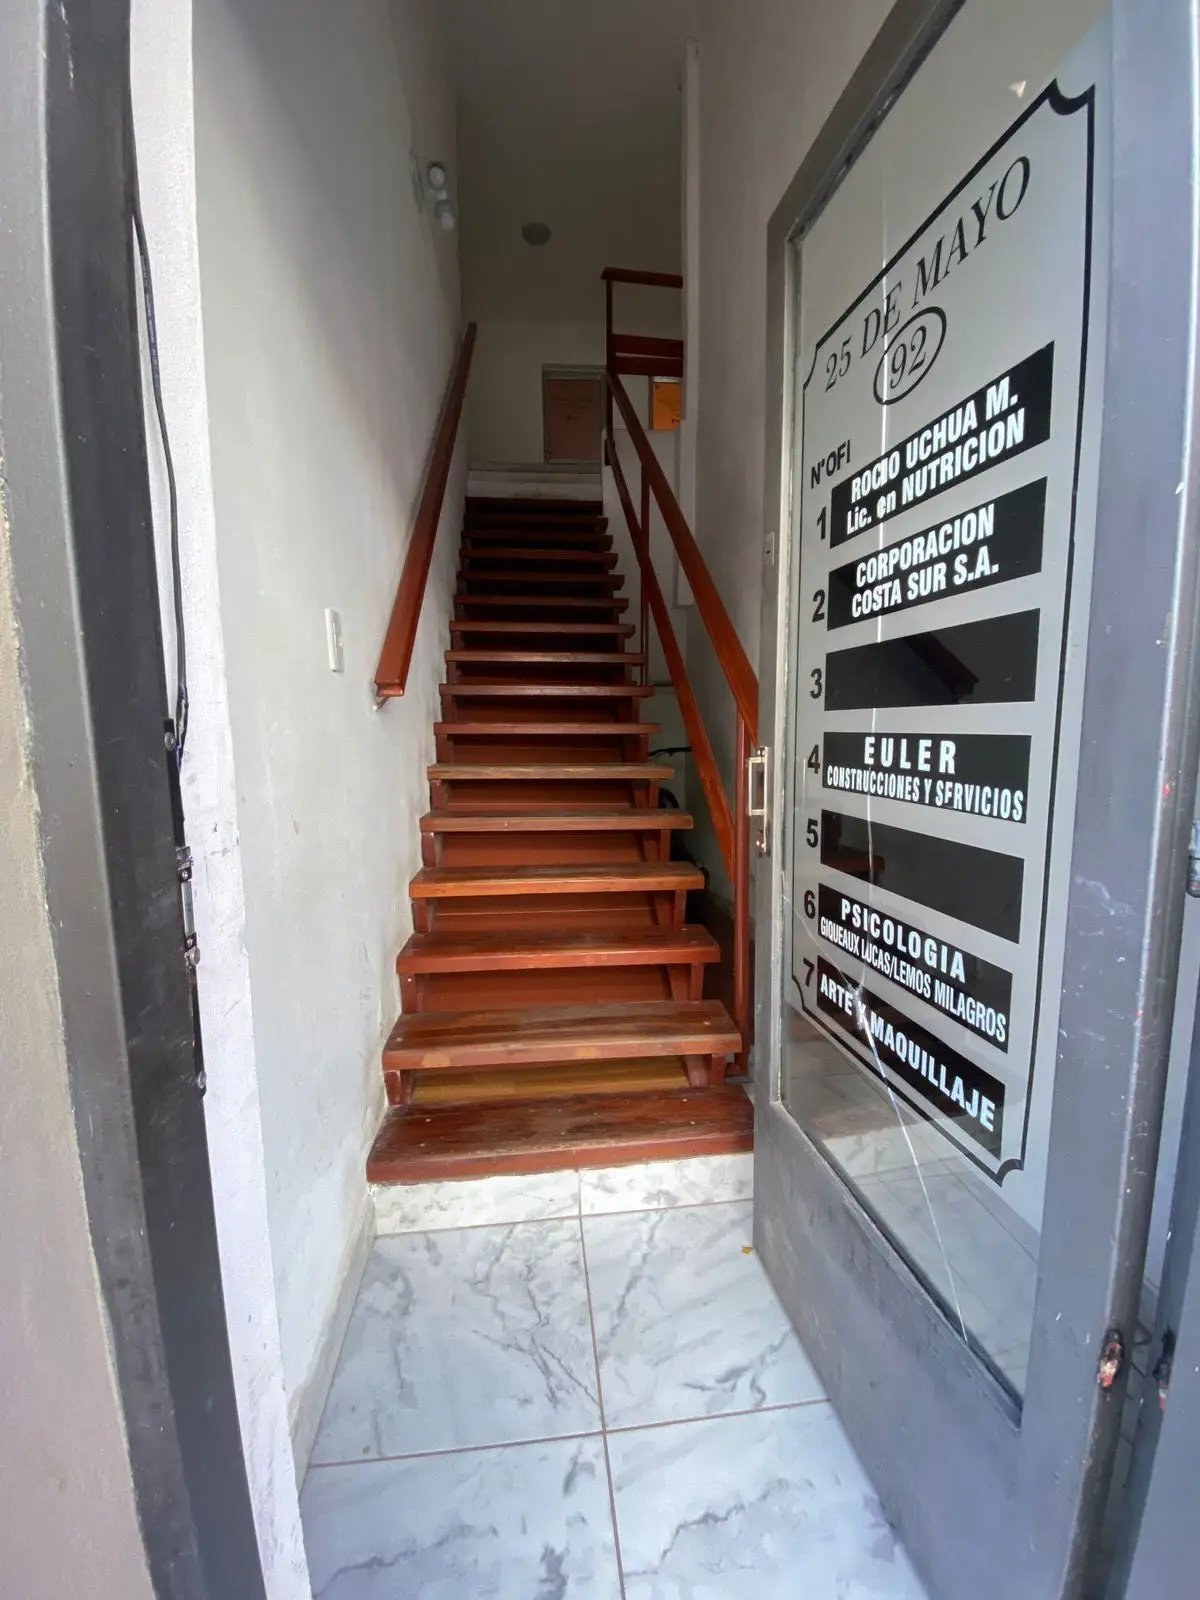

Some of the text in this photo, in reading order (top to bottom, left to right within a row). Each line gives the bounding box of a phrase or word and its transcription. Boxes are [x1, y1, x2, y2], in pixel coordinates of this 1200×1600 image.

[825, 156, 1030, 392] 25 DE MAYO
[889, 325, 927, 389] 92
[851, 376, 1018, 503] ROCIO UCHUA M.
[846, 408, 1025, 535] Lic. en NUTRICION
[816, 506, 827, 540] 1
[856, 503, 995, 588] CORPORACION
[812, 589, 826, 622] 2
[852, 545, 999, 618] COSTA SUR S.A.
[810, 668, 823, 699] 3
[807, 744, 821, 774] 4
[864, 736, 957, 774] EULER
[827, 765, 1024, 822] CONSTRUCCIONES Y SERVICIOS
[806, 818, 819, 848] 5
[803, 889, 816, 919] 6
[841, 898, 966, 984] PSICOLOGIA
[802, 956, 815, 987] 7
[861, 939, 931, 999] LUCAS/LEMOS
[934, 984, 1007, 1043] MILAGROS
[820, 973, 853, 1017] ARTE
[871, 1009, 996, 1132] MAQUILLAJE
